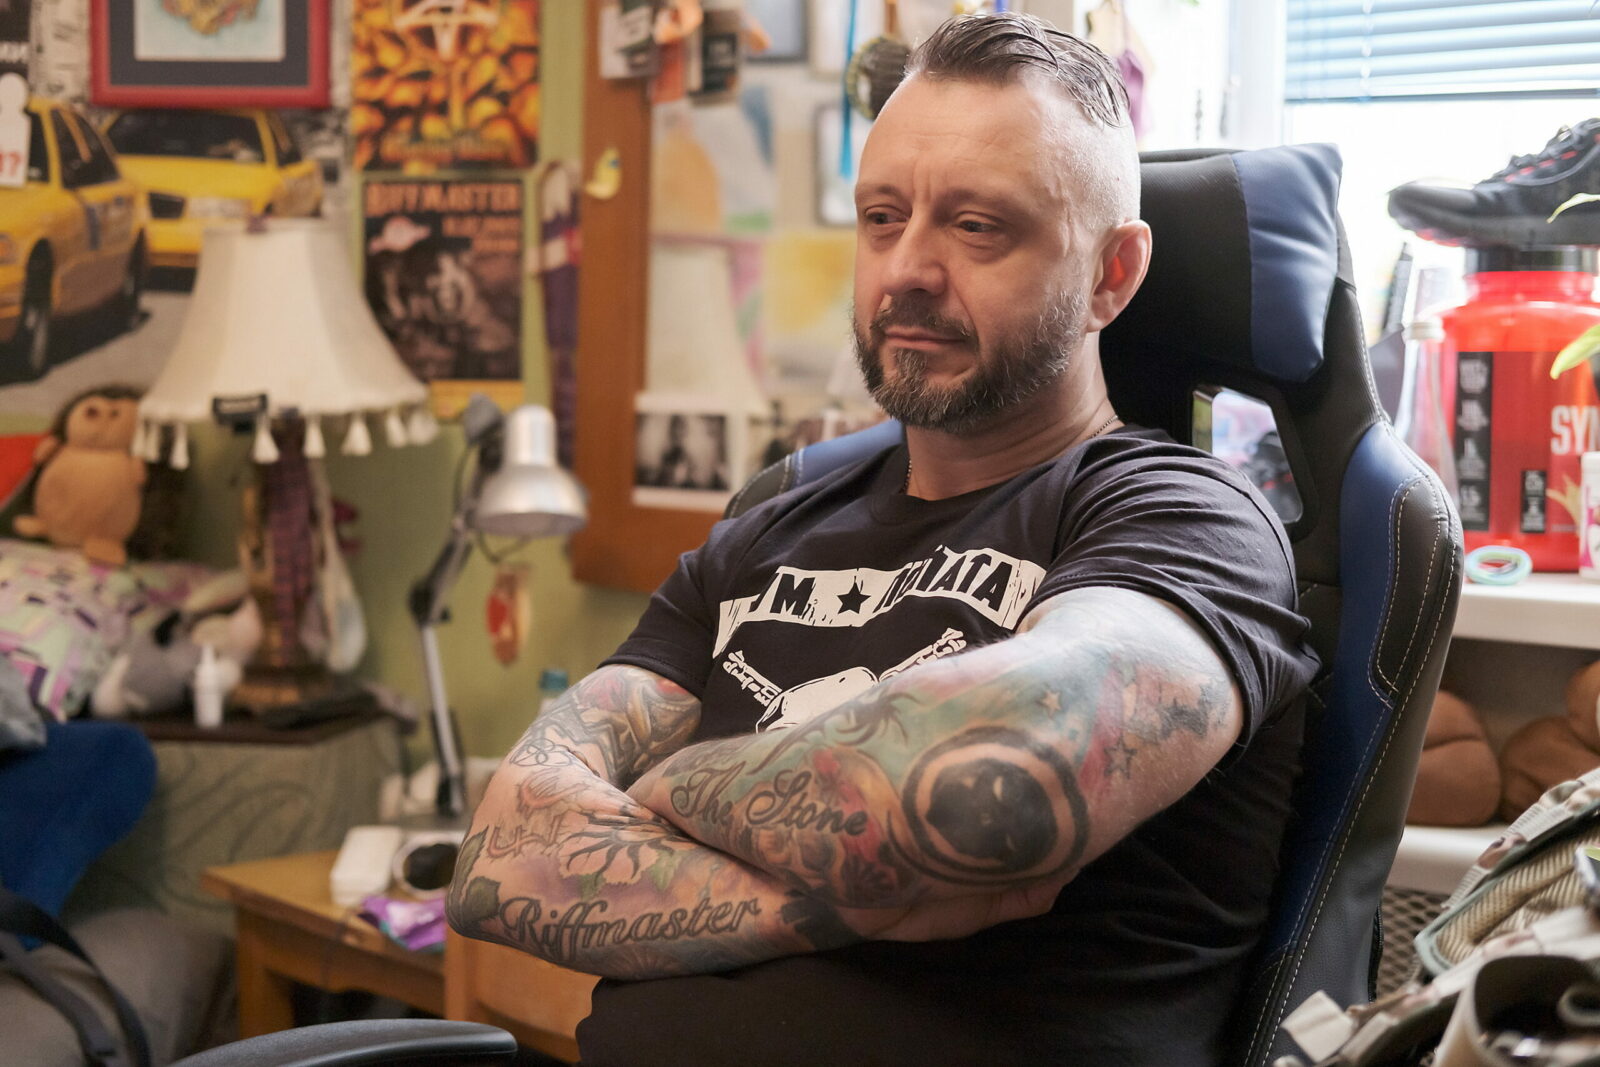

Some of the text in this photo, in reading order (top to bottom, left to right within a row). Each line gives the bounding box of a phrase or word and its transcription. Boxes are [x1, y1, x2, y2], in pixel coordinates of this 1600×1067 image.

[670, 761, 868, 836] The Stone
[499, 896, 762, 962] Riffmaster
